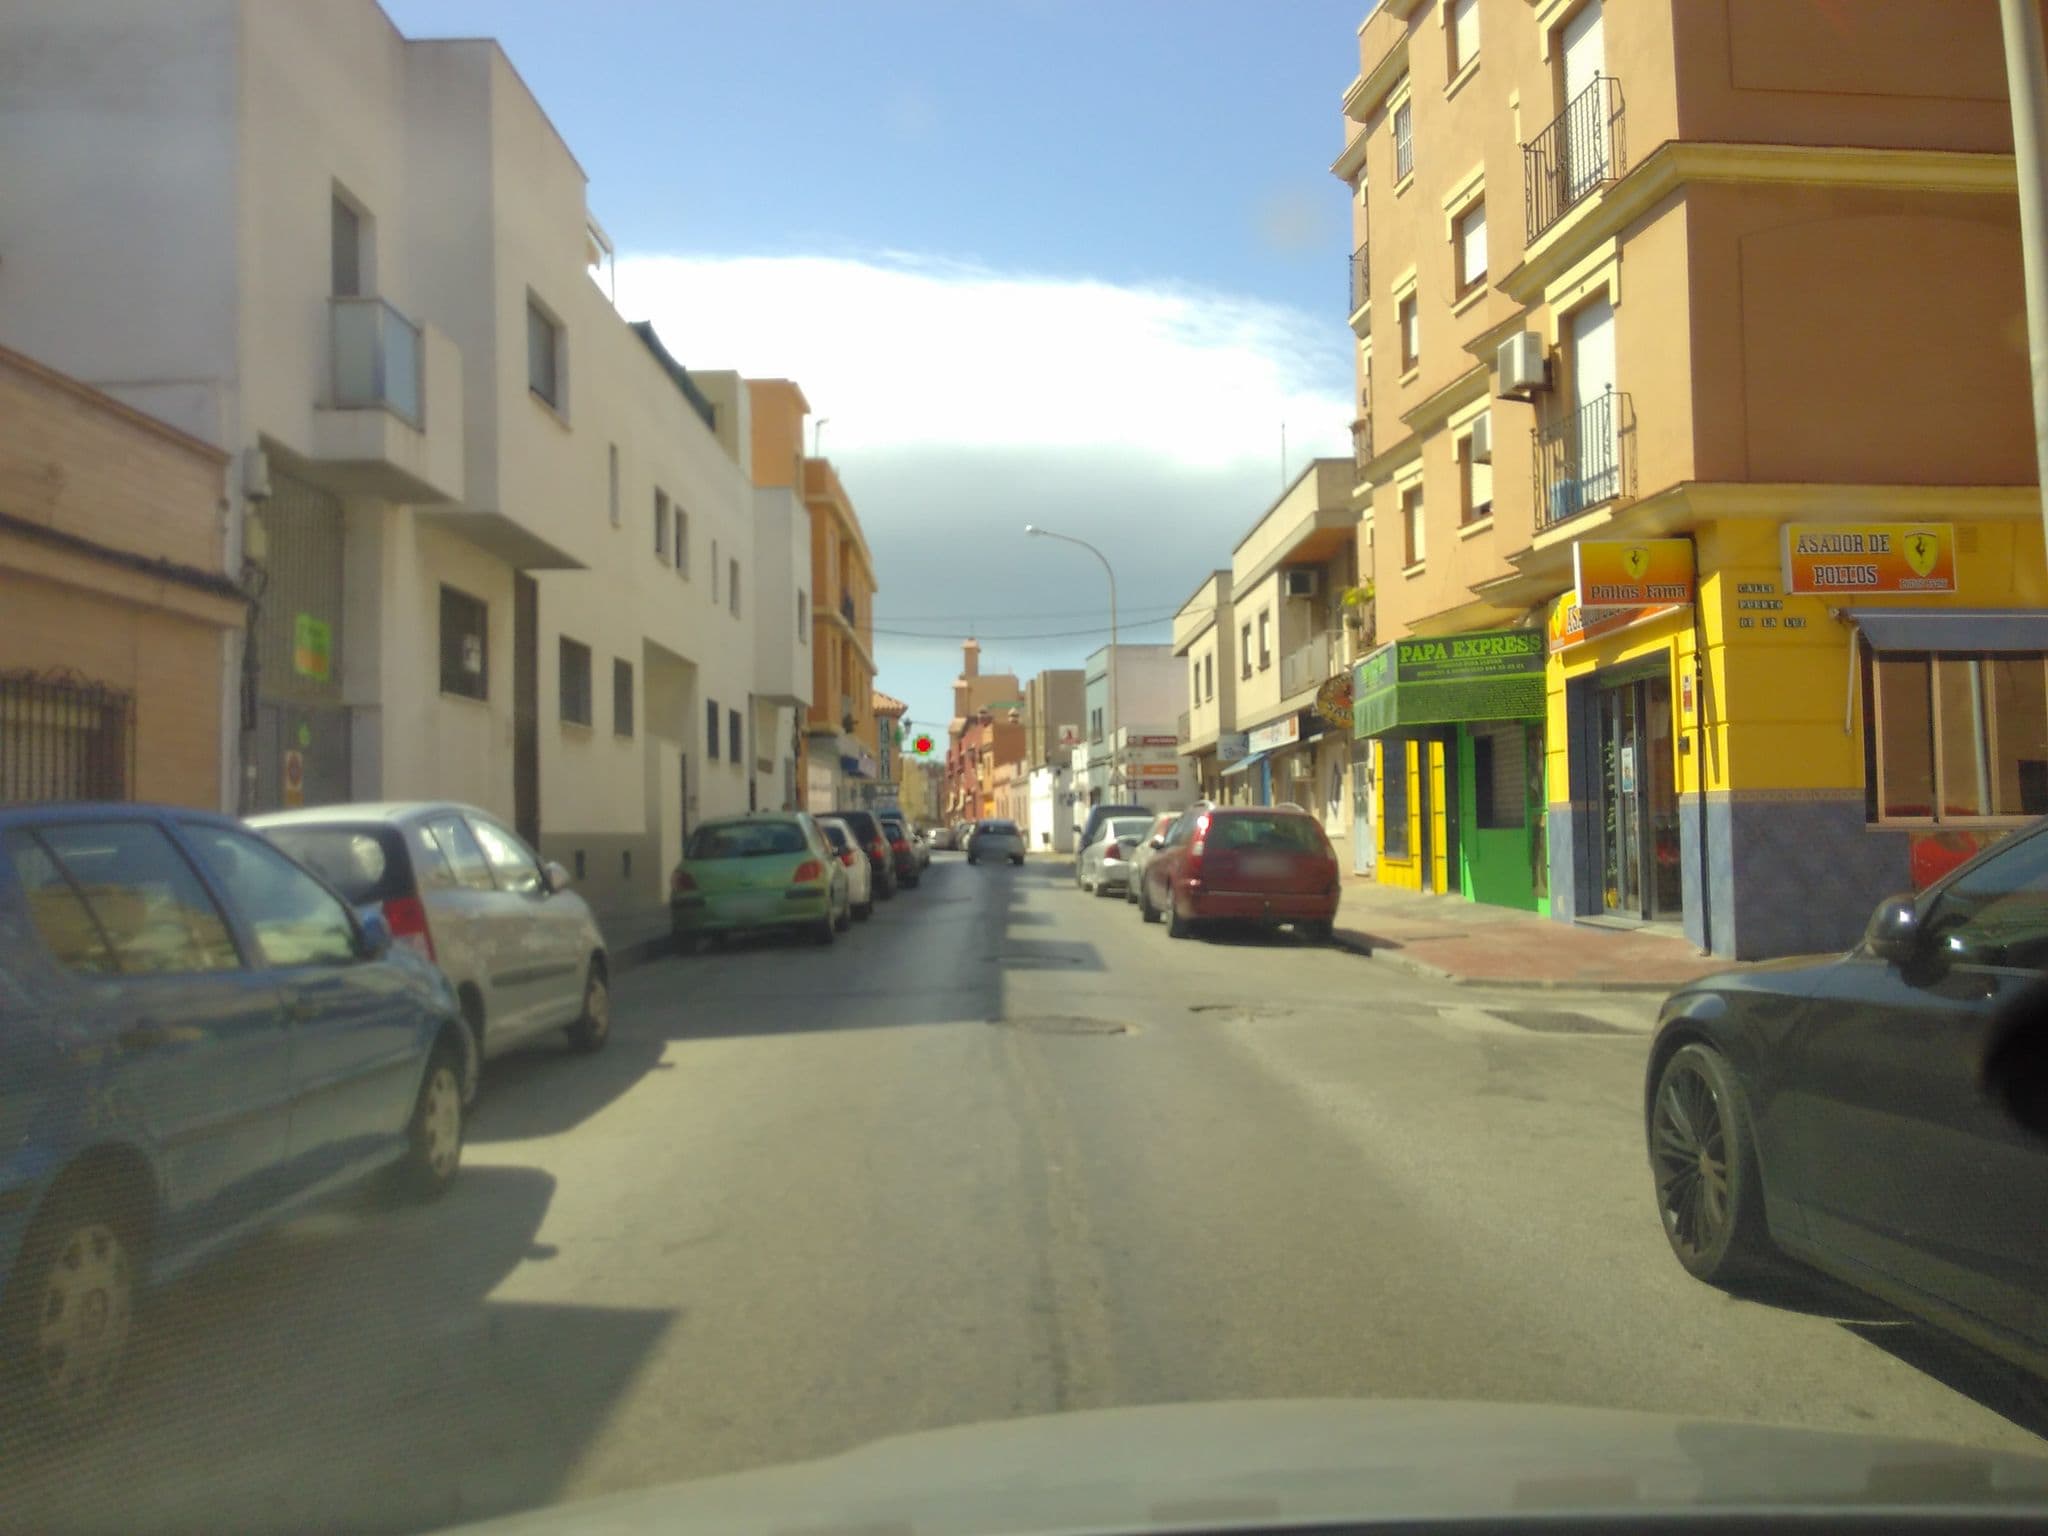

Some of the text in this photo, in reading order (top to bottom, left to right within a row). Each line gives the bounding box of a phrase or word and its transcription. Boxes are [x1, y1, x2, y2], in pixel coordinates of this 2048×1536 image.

[1797, 534, 1890, 554] ASADOR DE
[1814, 565, 1878, 585] POLLOS
[1737, 584, 1774, 593] CALLE
[1401, 643, 1449, 663] PAPA
[1453, 635, 1541, 658] EXPRESS
